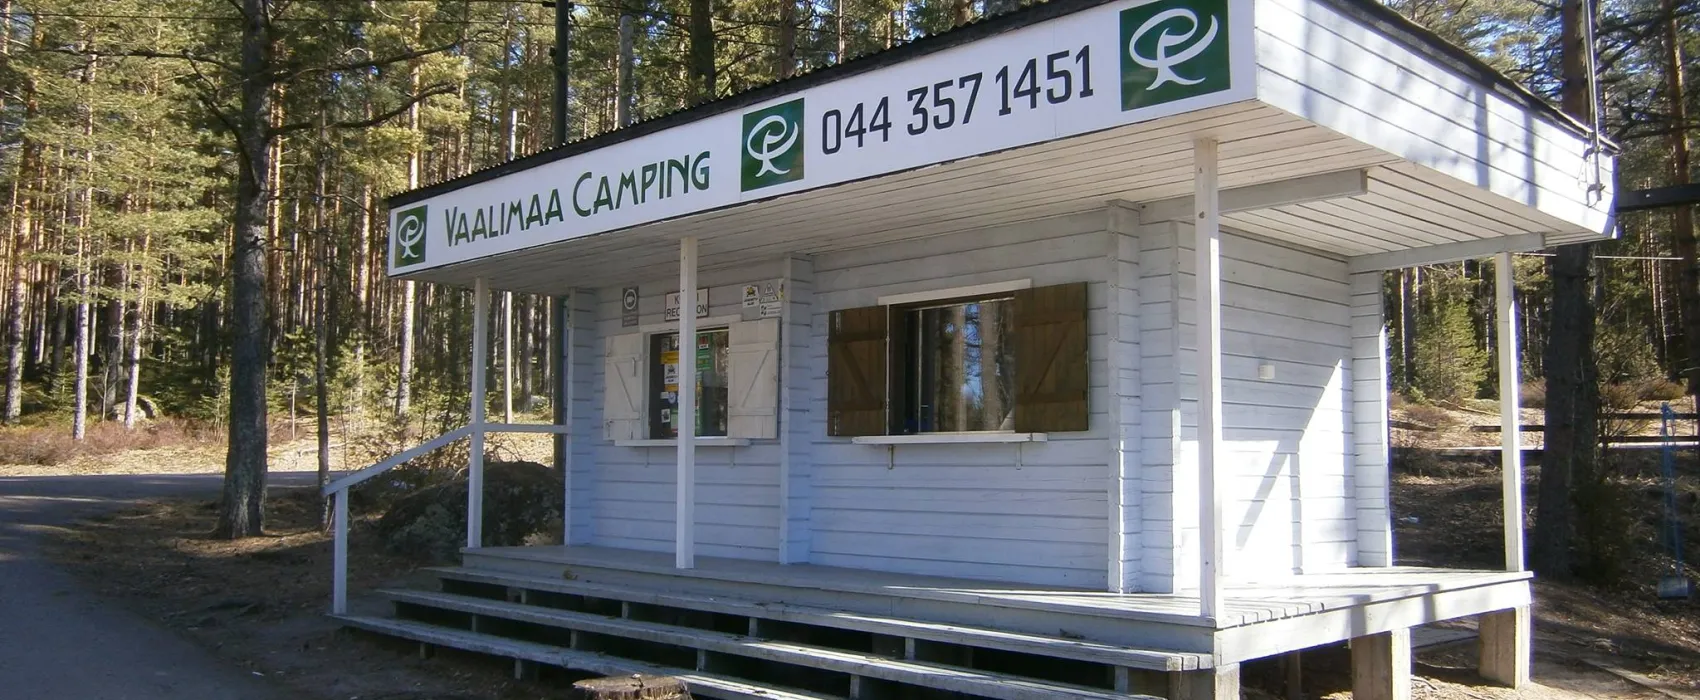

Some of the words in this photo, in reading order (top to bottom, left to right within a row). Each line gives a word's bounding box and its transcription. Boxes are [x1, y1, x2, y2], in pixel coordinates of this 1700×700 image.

[821, 95, 892, 155] 044
[906, 72, 983, 136] 357
[995, 44, 1094, 117] 1451
[666, 303, 707, 318] RECON
